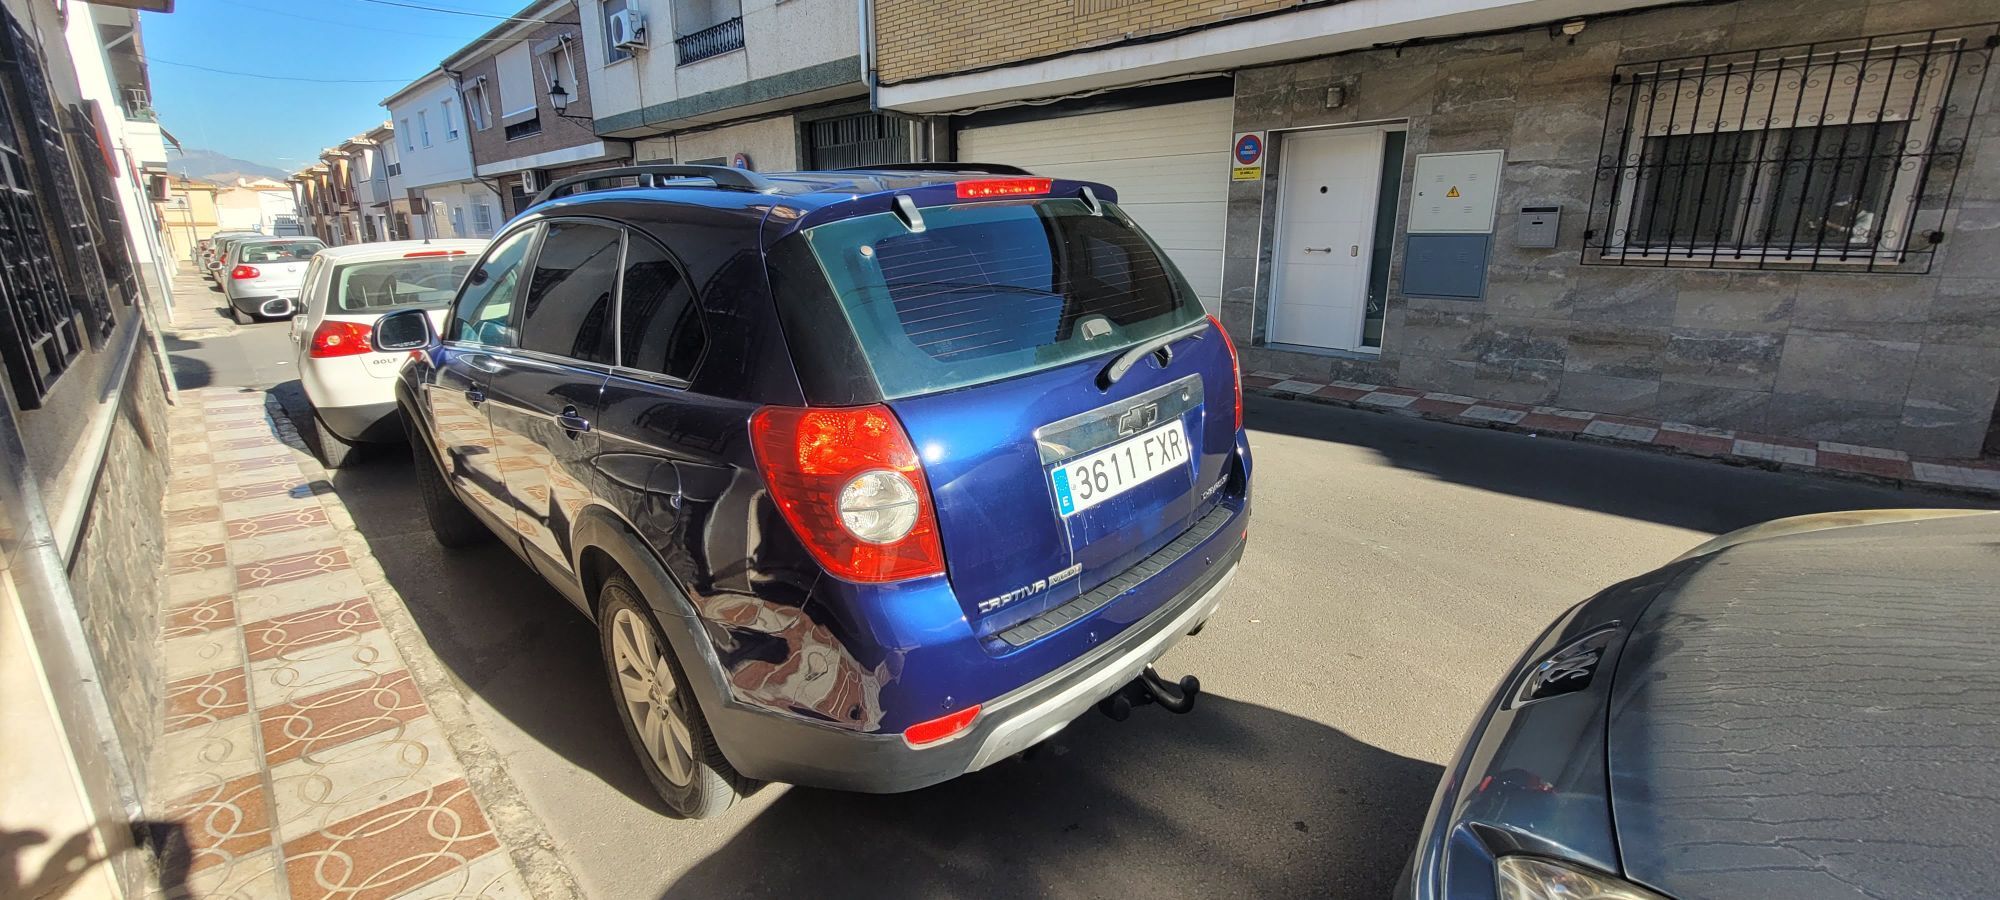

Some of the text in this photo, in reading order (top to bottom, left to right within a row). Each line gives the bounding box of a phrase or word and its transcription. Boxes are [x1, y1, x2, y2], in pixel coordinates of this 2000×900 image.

[1076, 428, 1182, 500] 3611 FXR
[1062, 495, 1070, 507] E
[978, 579, 1047, 613] CAPTIVA
